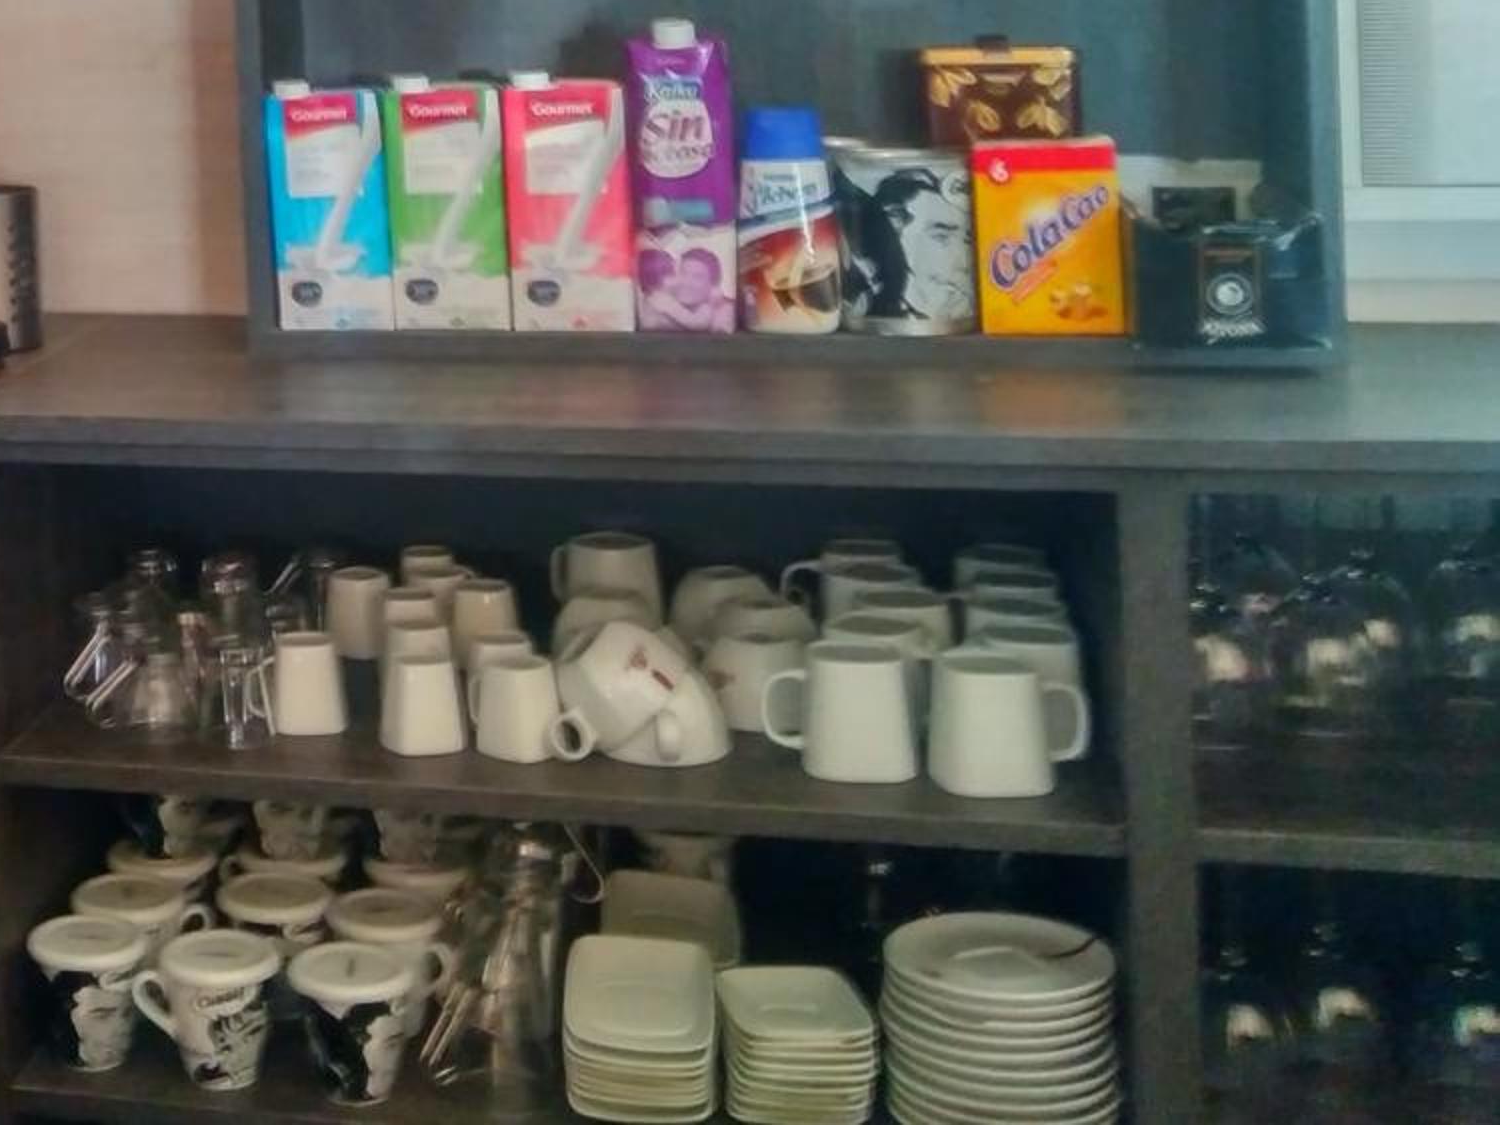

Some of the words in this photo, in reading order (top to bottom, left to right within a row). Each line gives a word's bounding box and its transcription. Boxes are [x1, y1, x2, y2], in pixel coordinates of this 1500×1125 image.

[288, 107, 348, 122] Gourmet
[408, 103, 468, 119] Gourmet
[530, 102, 591, 117] Gourmet
